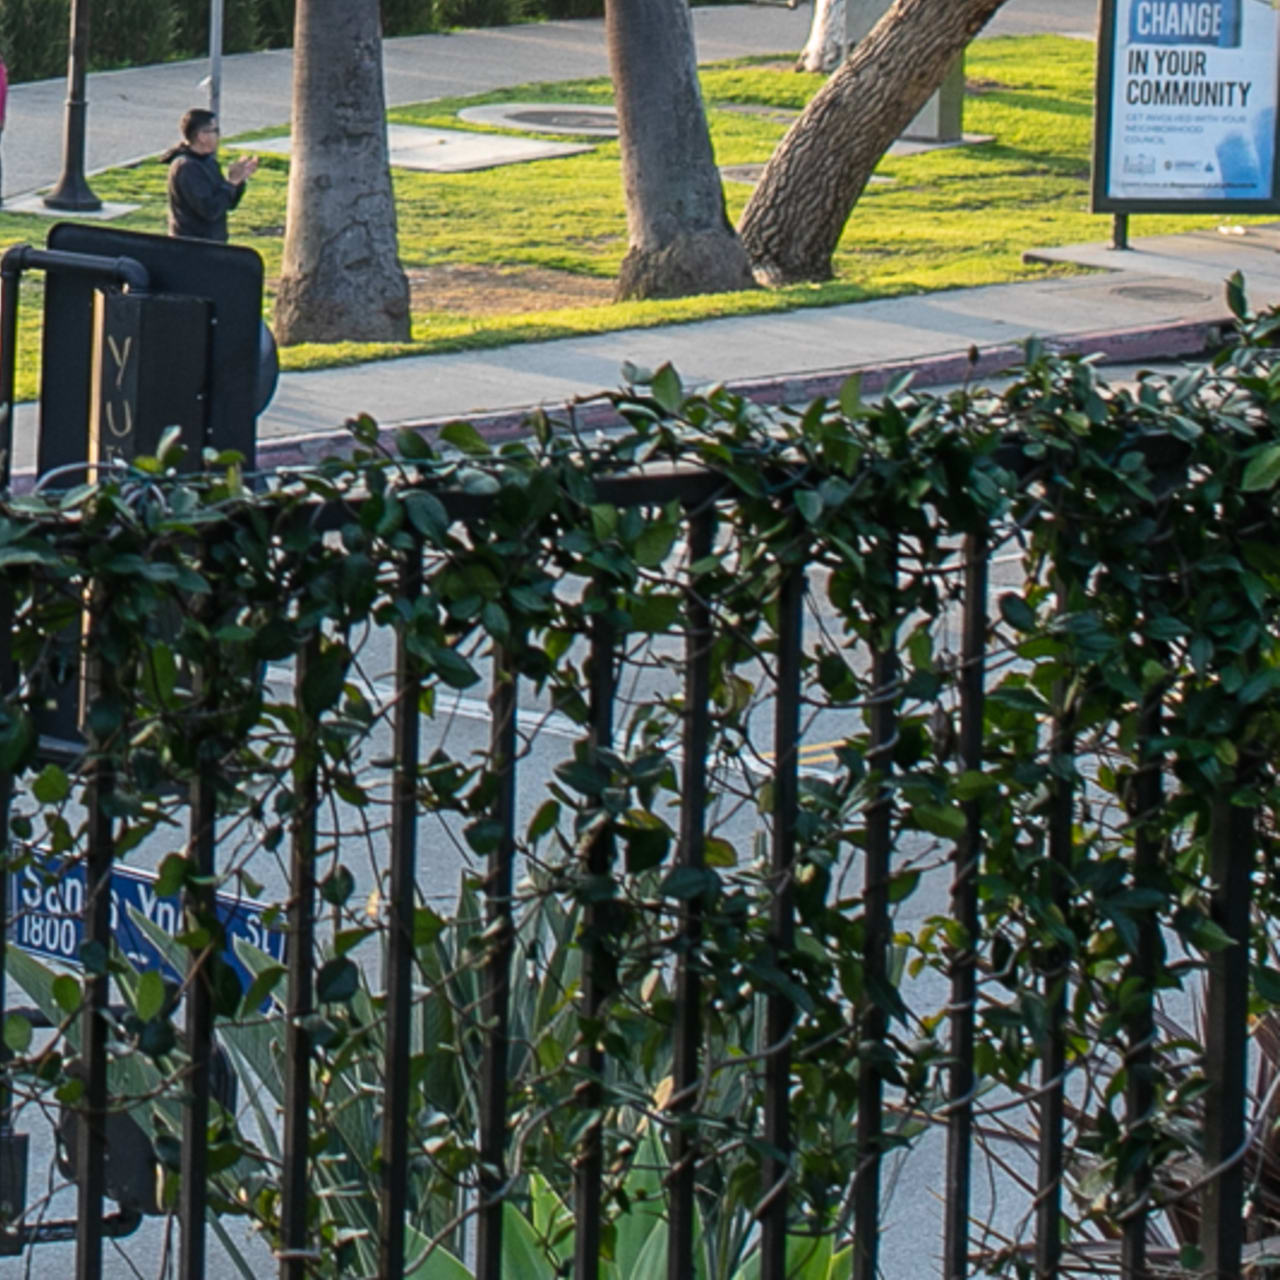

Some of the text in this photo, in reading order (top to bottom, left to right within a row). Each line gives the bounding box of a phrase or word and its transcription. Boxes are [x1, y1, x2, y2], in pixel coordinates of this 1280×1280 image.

[1136, 0, 1223, 37] CHANGE
[1127, 49, 1207, 77] IN YOUR
[1125, 79, 1253, 108] COMMUNITY
[22, 913, 76, 956] 1800
